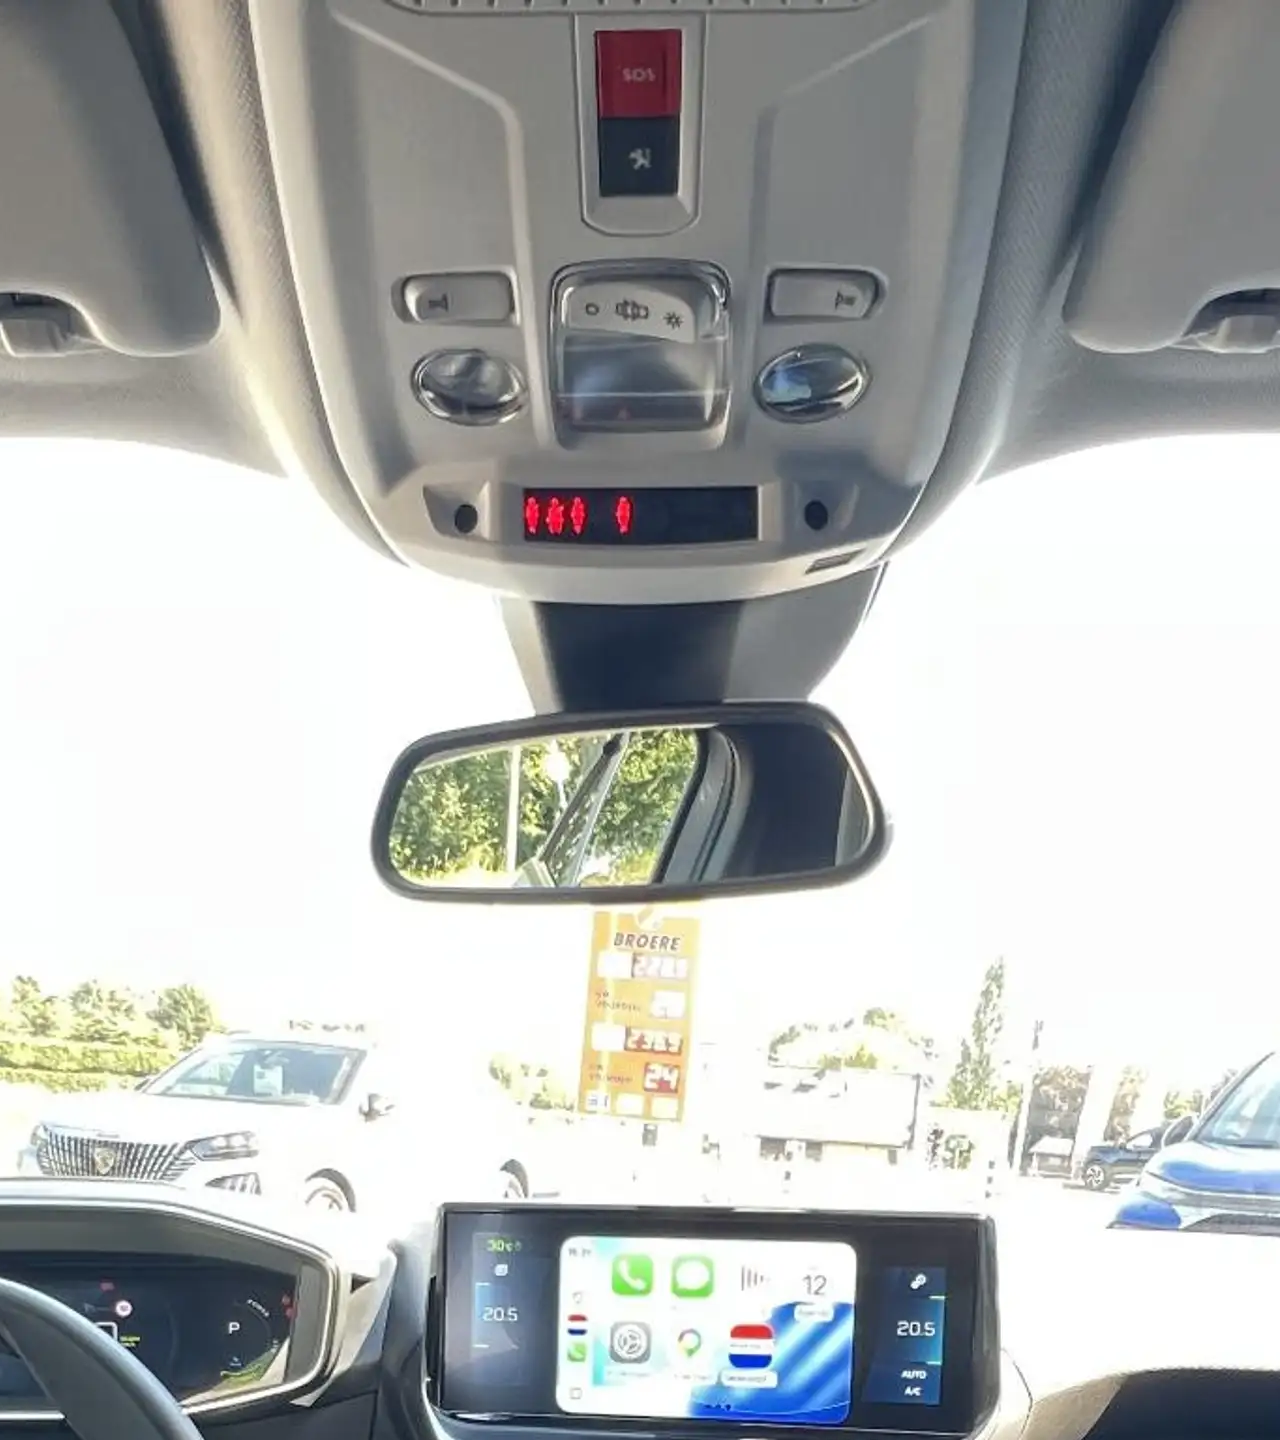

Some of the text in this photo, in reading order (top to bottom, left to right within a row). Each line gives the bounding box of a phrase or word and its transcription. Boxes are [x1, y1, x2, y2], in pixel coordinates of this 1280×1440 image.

[613, 932, 681, 951] BROERE
[802, 1274, 827, 1296] 12
[482, 1307, 518, 1321] 20.5
[228, 1321, 241, 1335] P
[896, 1320, 936, 1336] 20.5
